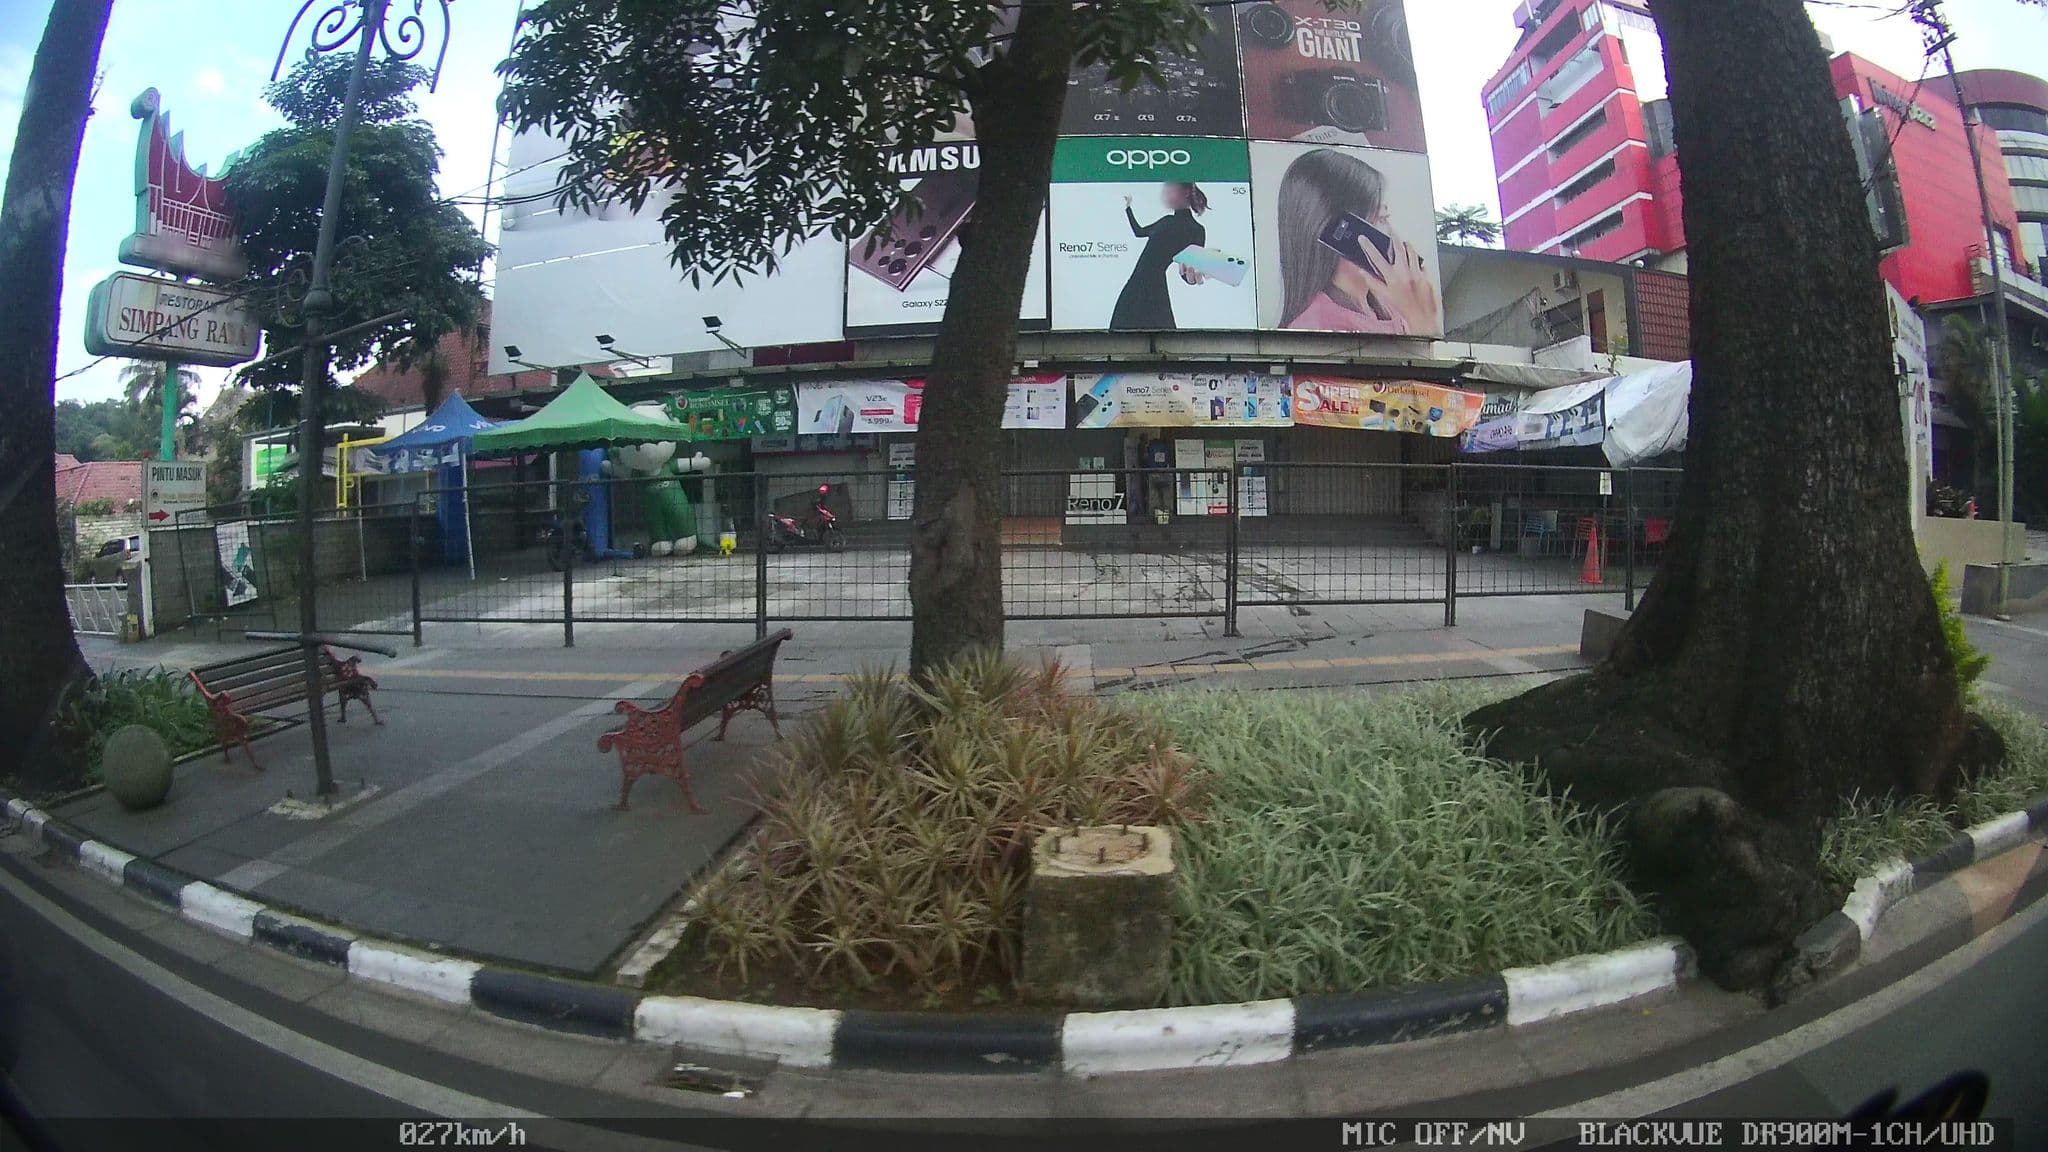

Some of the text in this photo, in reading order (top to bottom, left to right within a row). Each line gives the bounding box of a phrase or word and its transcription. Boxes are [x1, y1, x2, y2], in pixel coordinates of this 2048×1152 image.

[1294, 15, 1361, 31] X-T30
[1296, 27, 1362, 63] GIANT
[1059, 241, 1129, 252] Reno7 Series
[902, 300, 933, 309] Galaxy
[118, 306, 199, 341] SIMPANG
[1126, 386, 1150, 394] Reno7
[151, 467, 203, 481] PINTU MASUK
